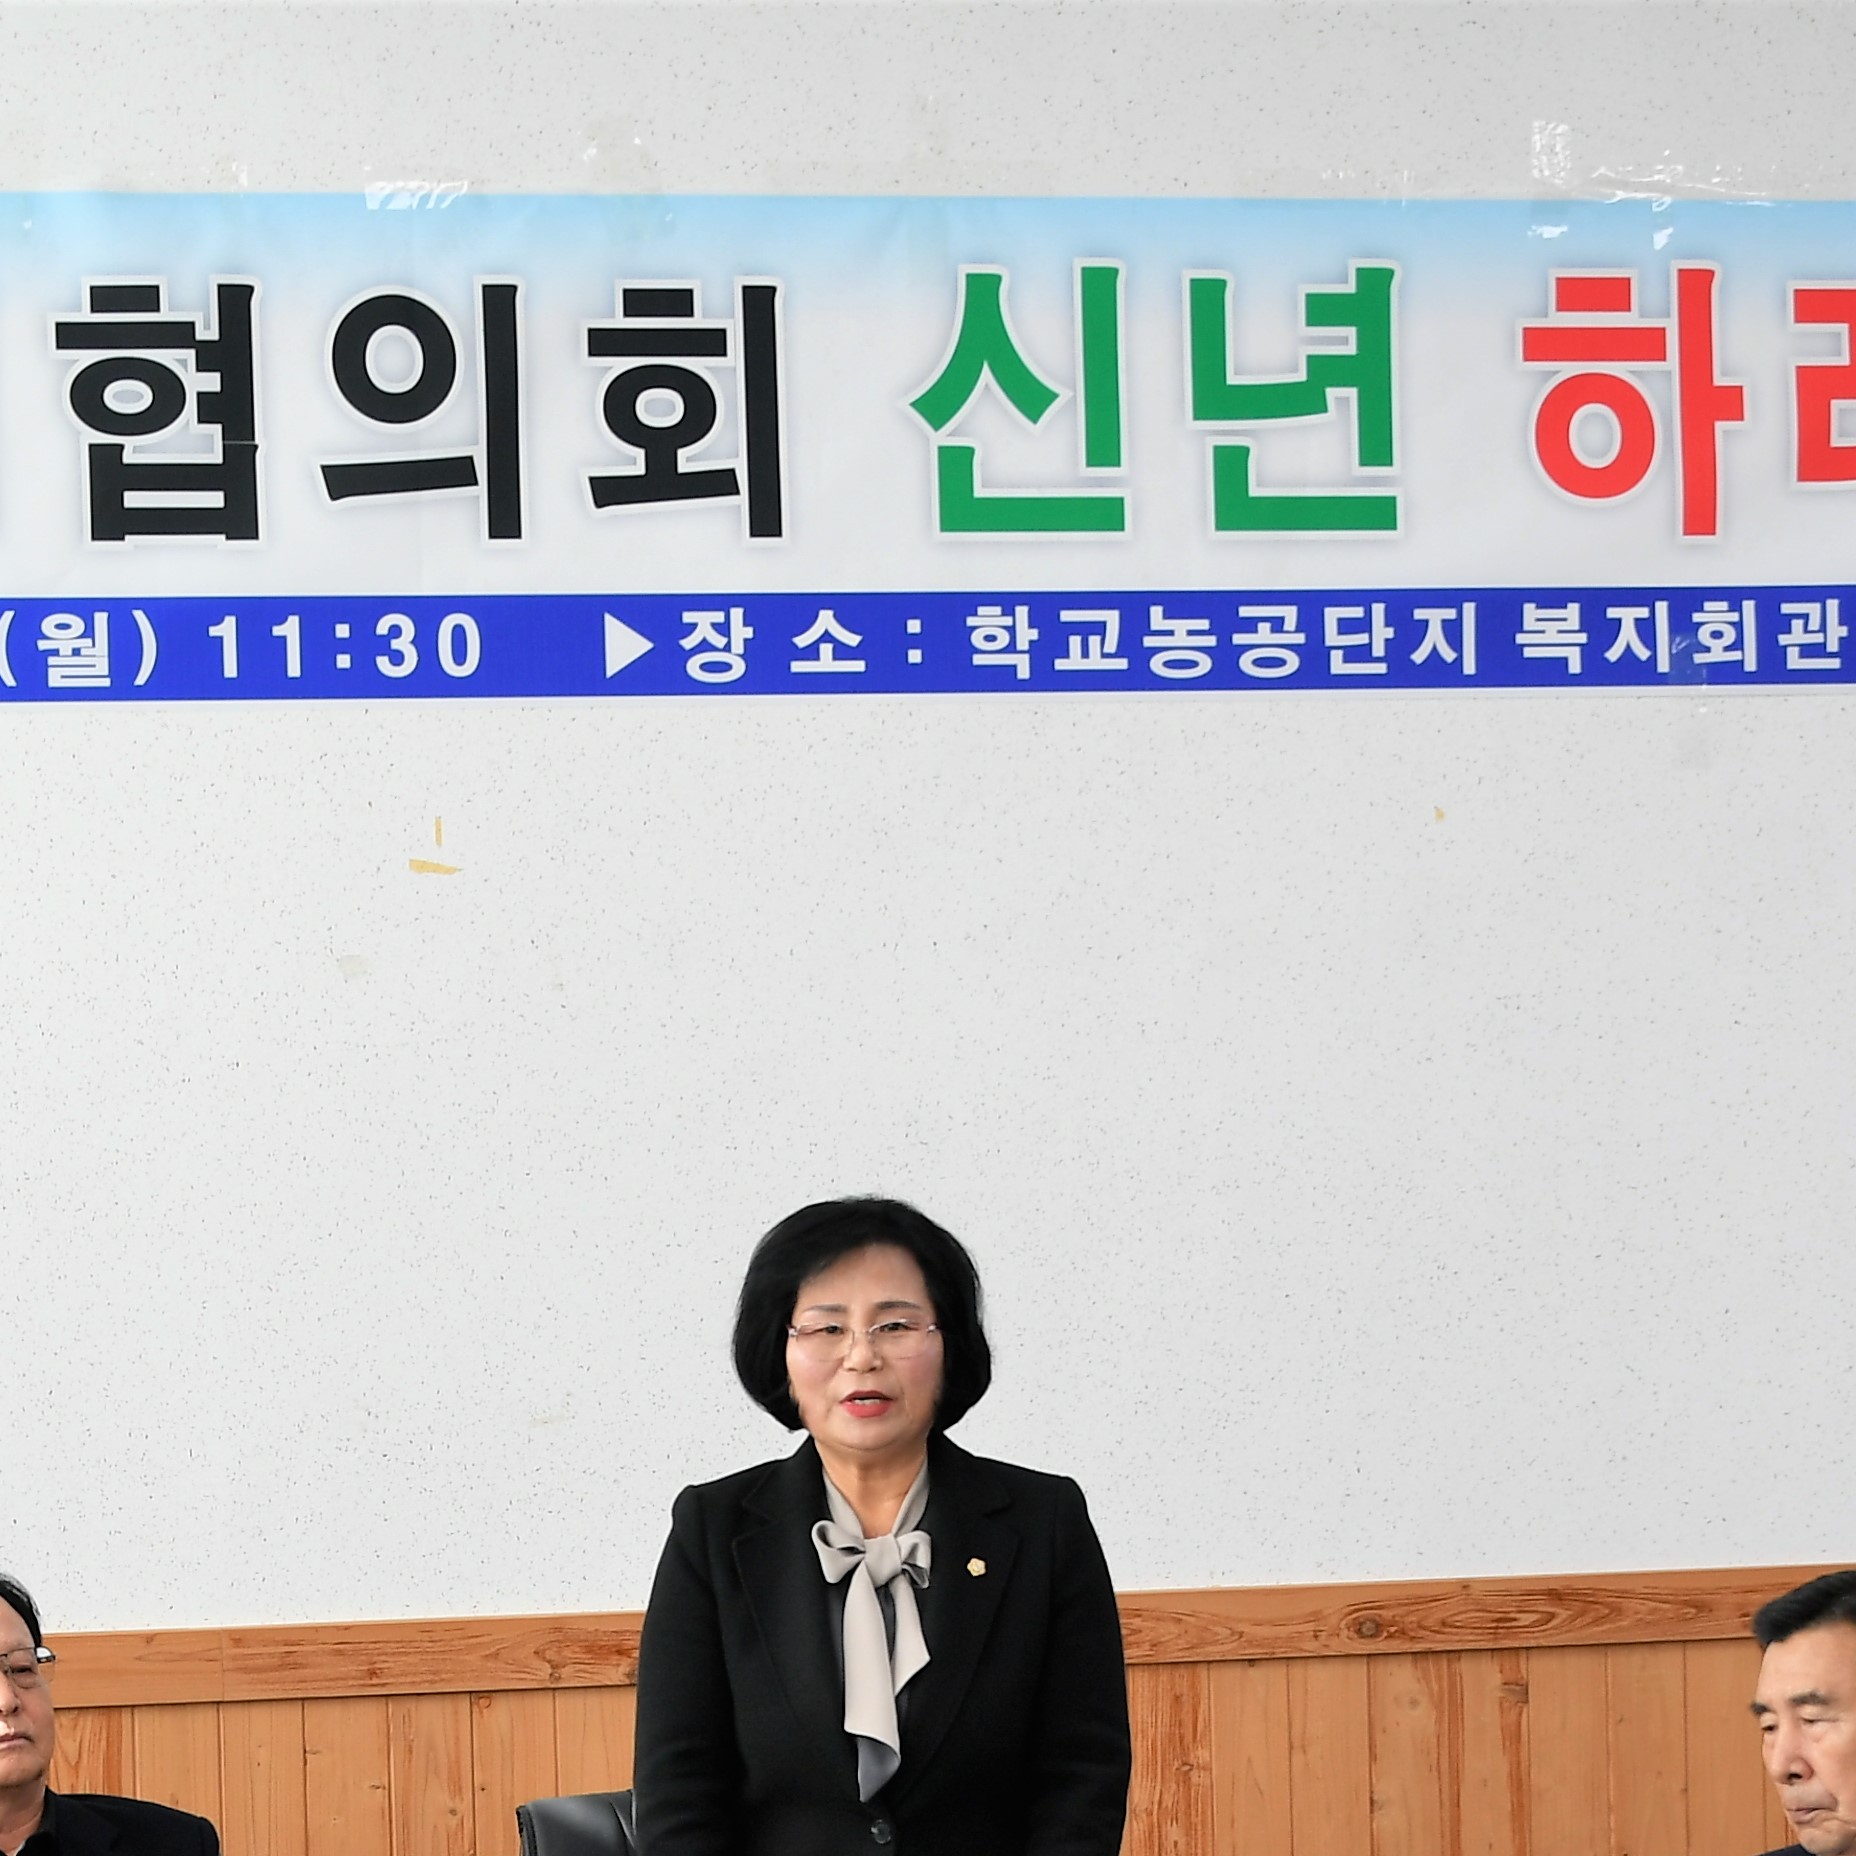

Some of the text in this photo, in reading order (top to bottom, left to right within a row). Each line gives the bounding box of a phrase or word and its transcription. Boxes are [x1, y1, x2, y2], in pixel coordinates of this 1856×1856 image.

[913, 267, 1397, 531] 신년
[209, 613, 480, 677] 11:30
[967, 603, 1475, 679] 학교농공단지
[1516, 599, 1847, 673] 복지회관
